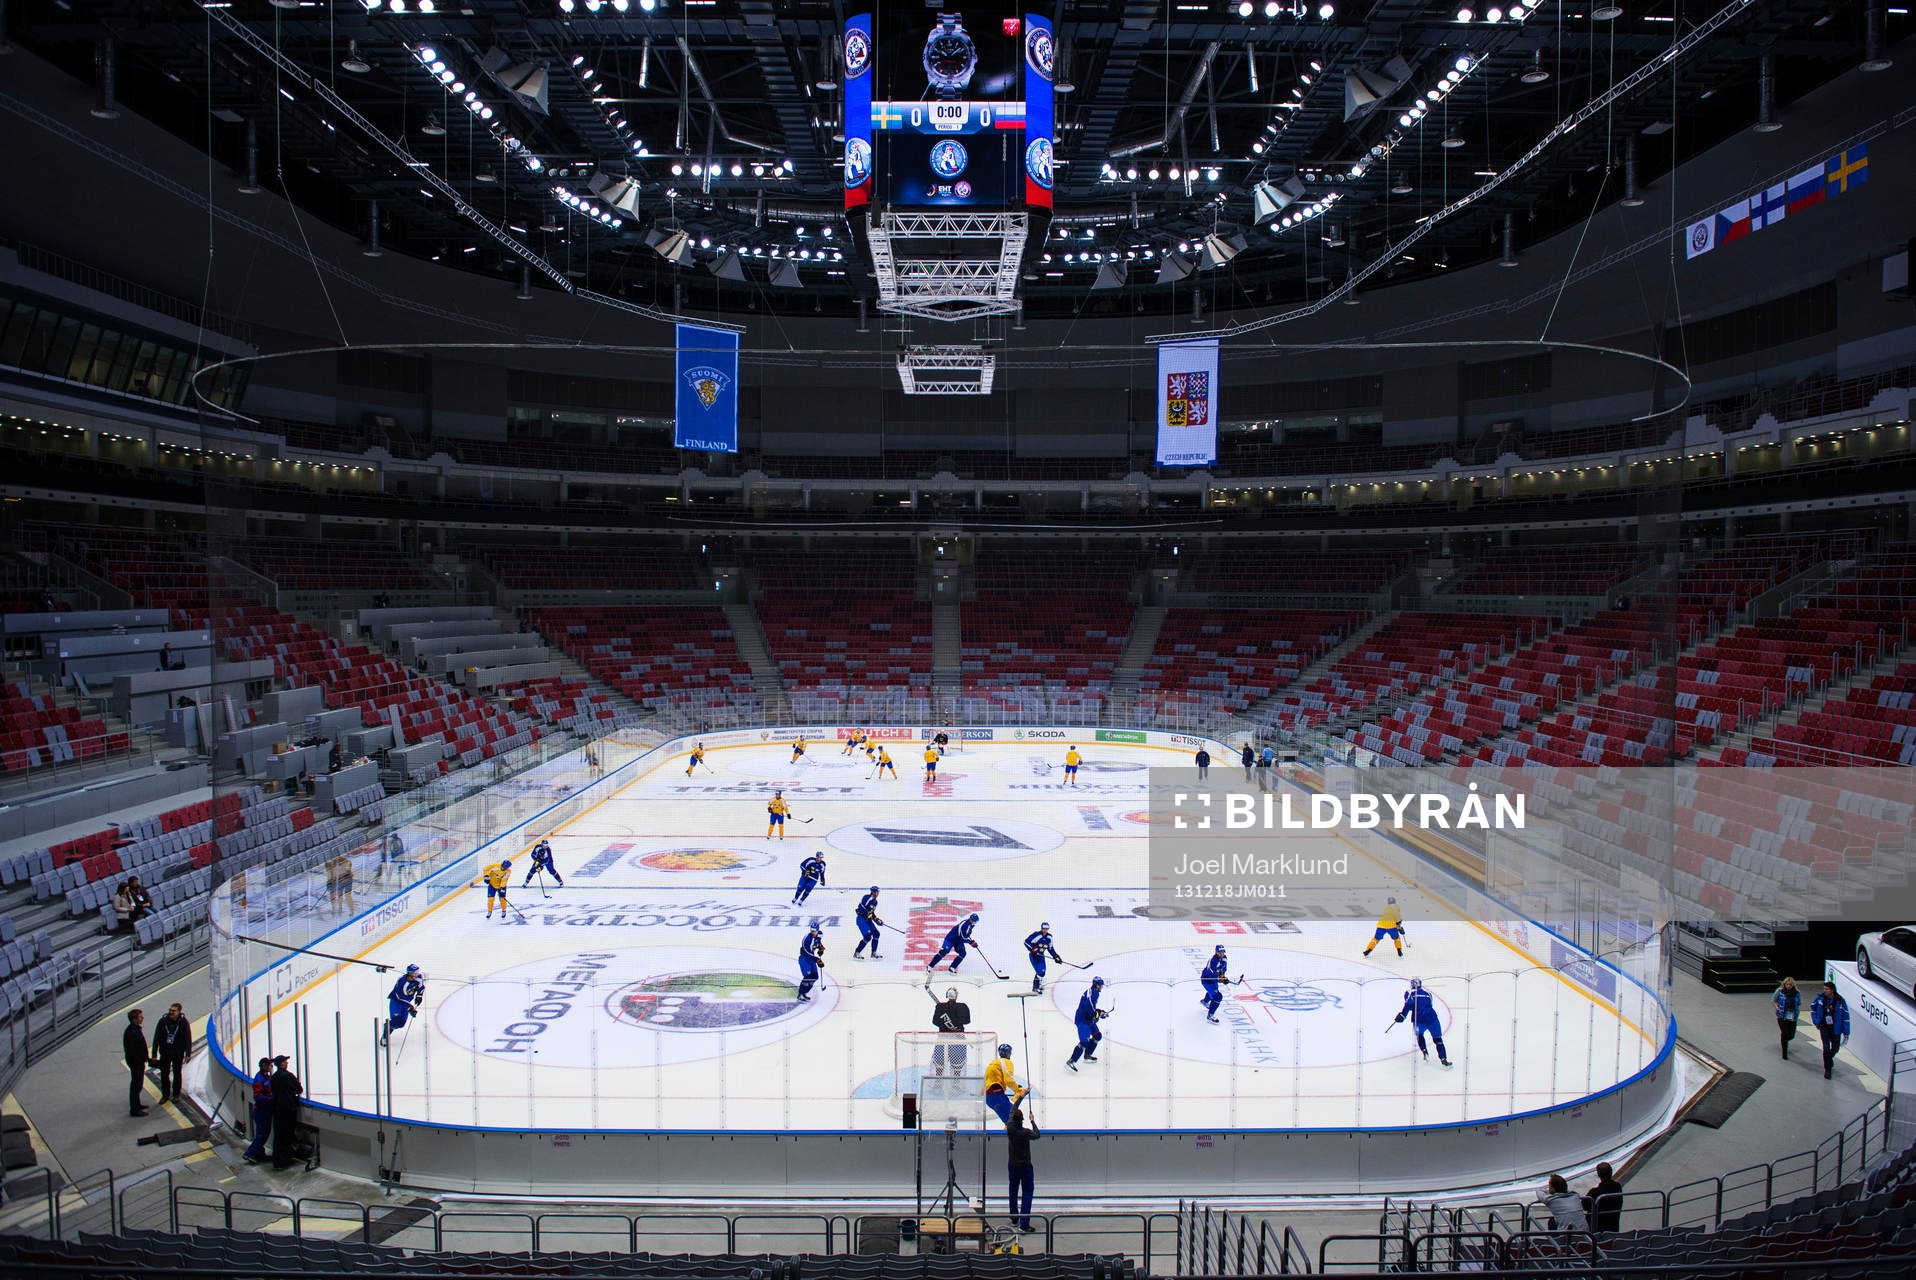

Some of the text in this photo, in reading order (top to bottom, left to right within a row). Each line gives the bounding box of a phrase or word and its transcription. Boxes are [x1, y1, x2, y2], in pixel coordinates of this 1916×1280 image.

[911, 108, 922, 127] 0
[937, 106, 962, 118] 0:00
[980, 108, 991, 127] 0
[691, 370, 723, 382] SUOMI
[685, 438, 728, 450] FINLAND
[1028, 730, 1066, 738] ŠKODA
[1182, 736, 1206, 747] TISSOT
[376, 895, 410, 927] TISSOT
[1078, 905, 1384, 919] TISSOT
[1861, 994, 1889, 1026] Superb
